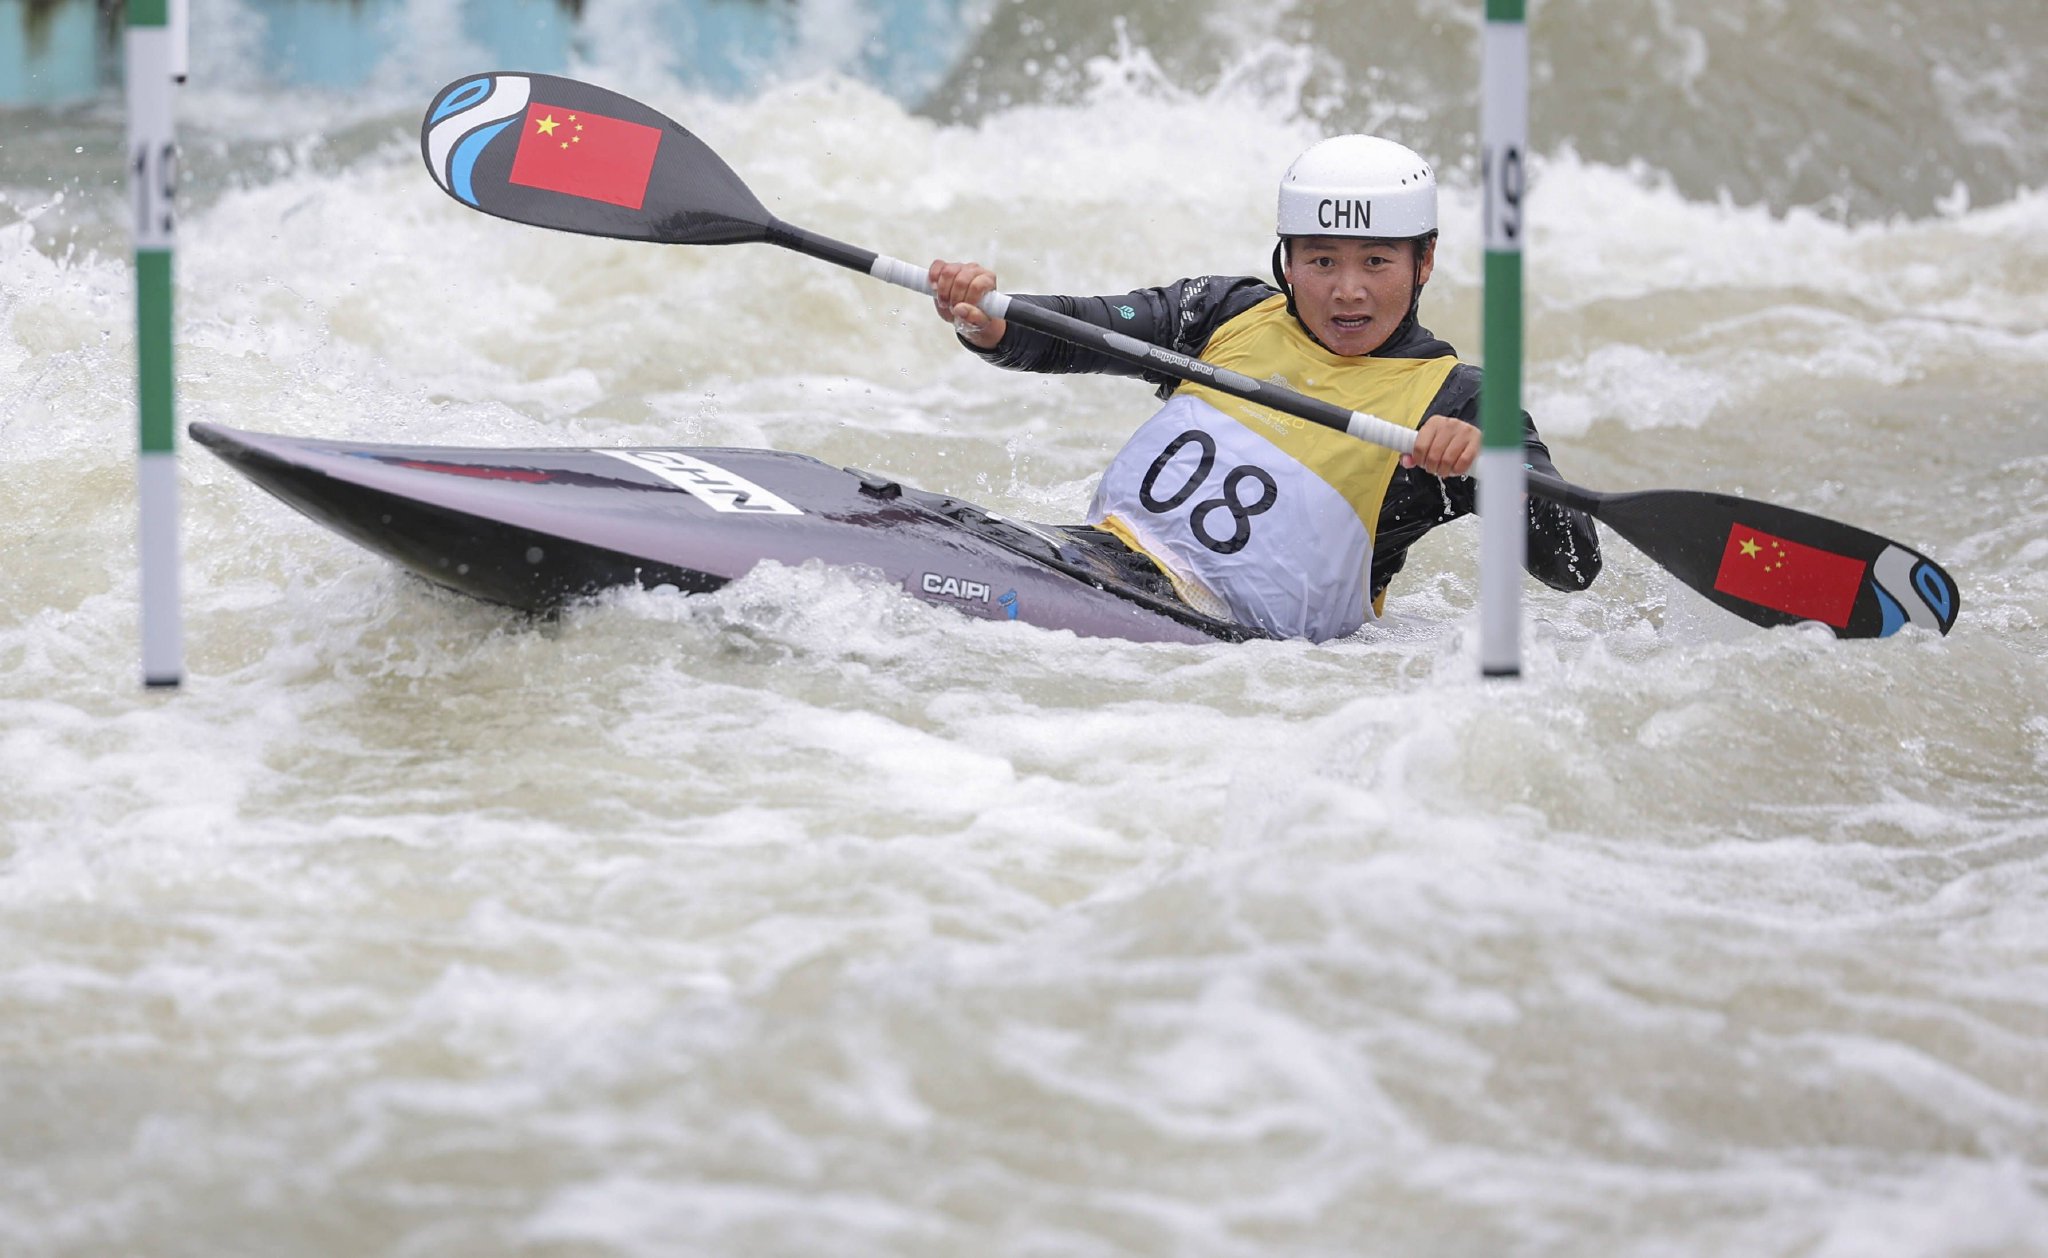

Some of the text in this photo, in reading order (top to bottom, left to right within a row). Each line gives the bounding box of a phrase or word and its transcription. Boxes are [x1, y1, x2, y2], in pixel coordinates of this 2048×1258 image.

[1318, 199, 1371, 229] CHN
[1150, 348, 1189, 369] paddles
[625, 451, 775, 512] CHN
[1139, 429, 1278, 555] 08
[922, 573, 991, 603] CAIPI
